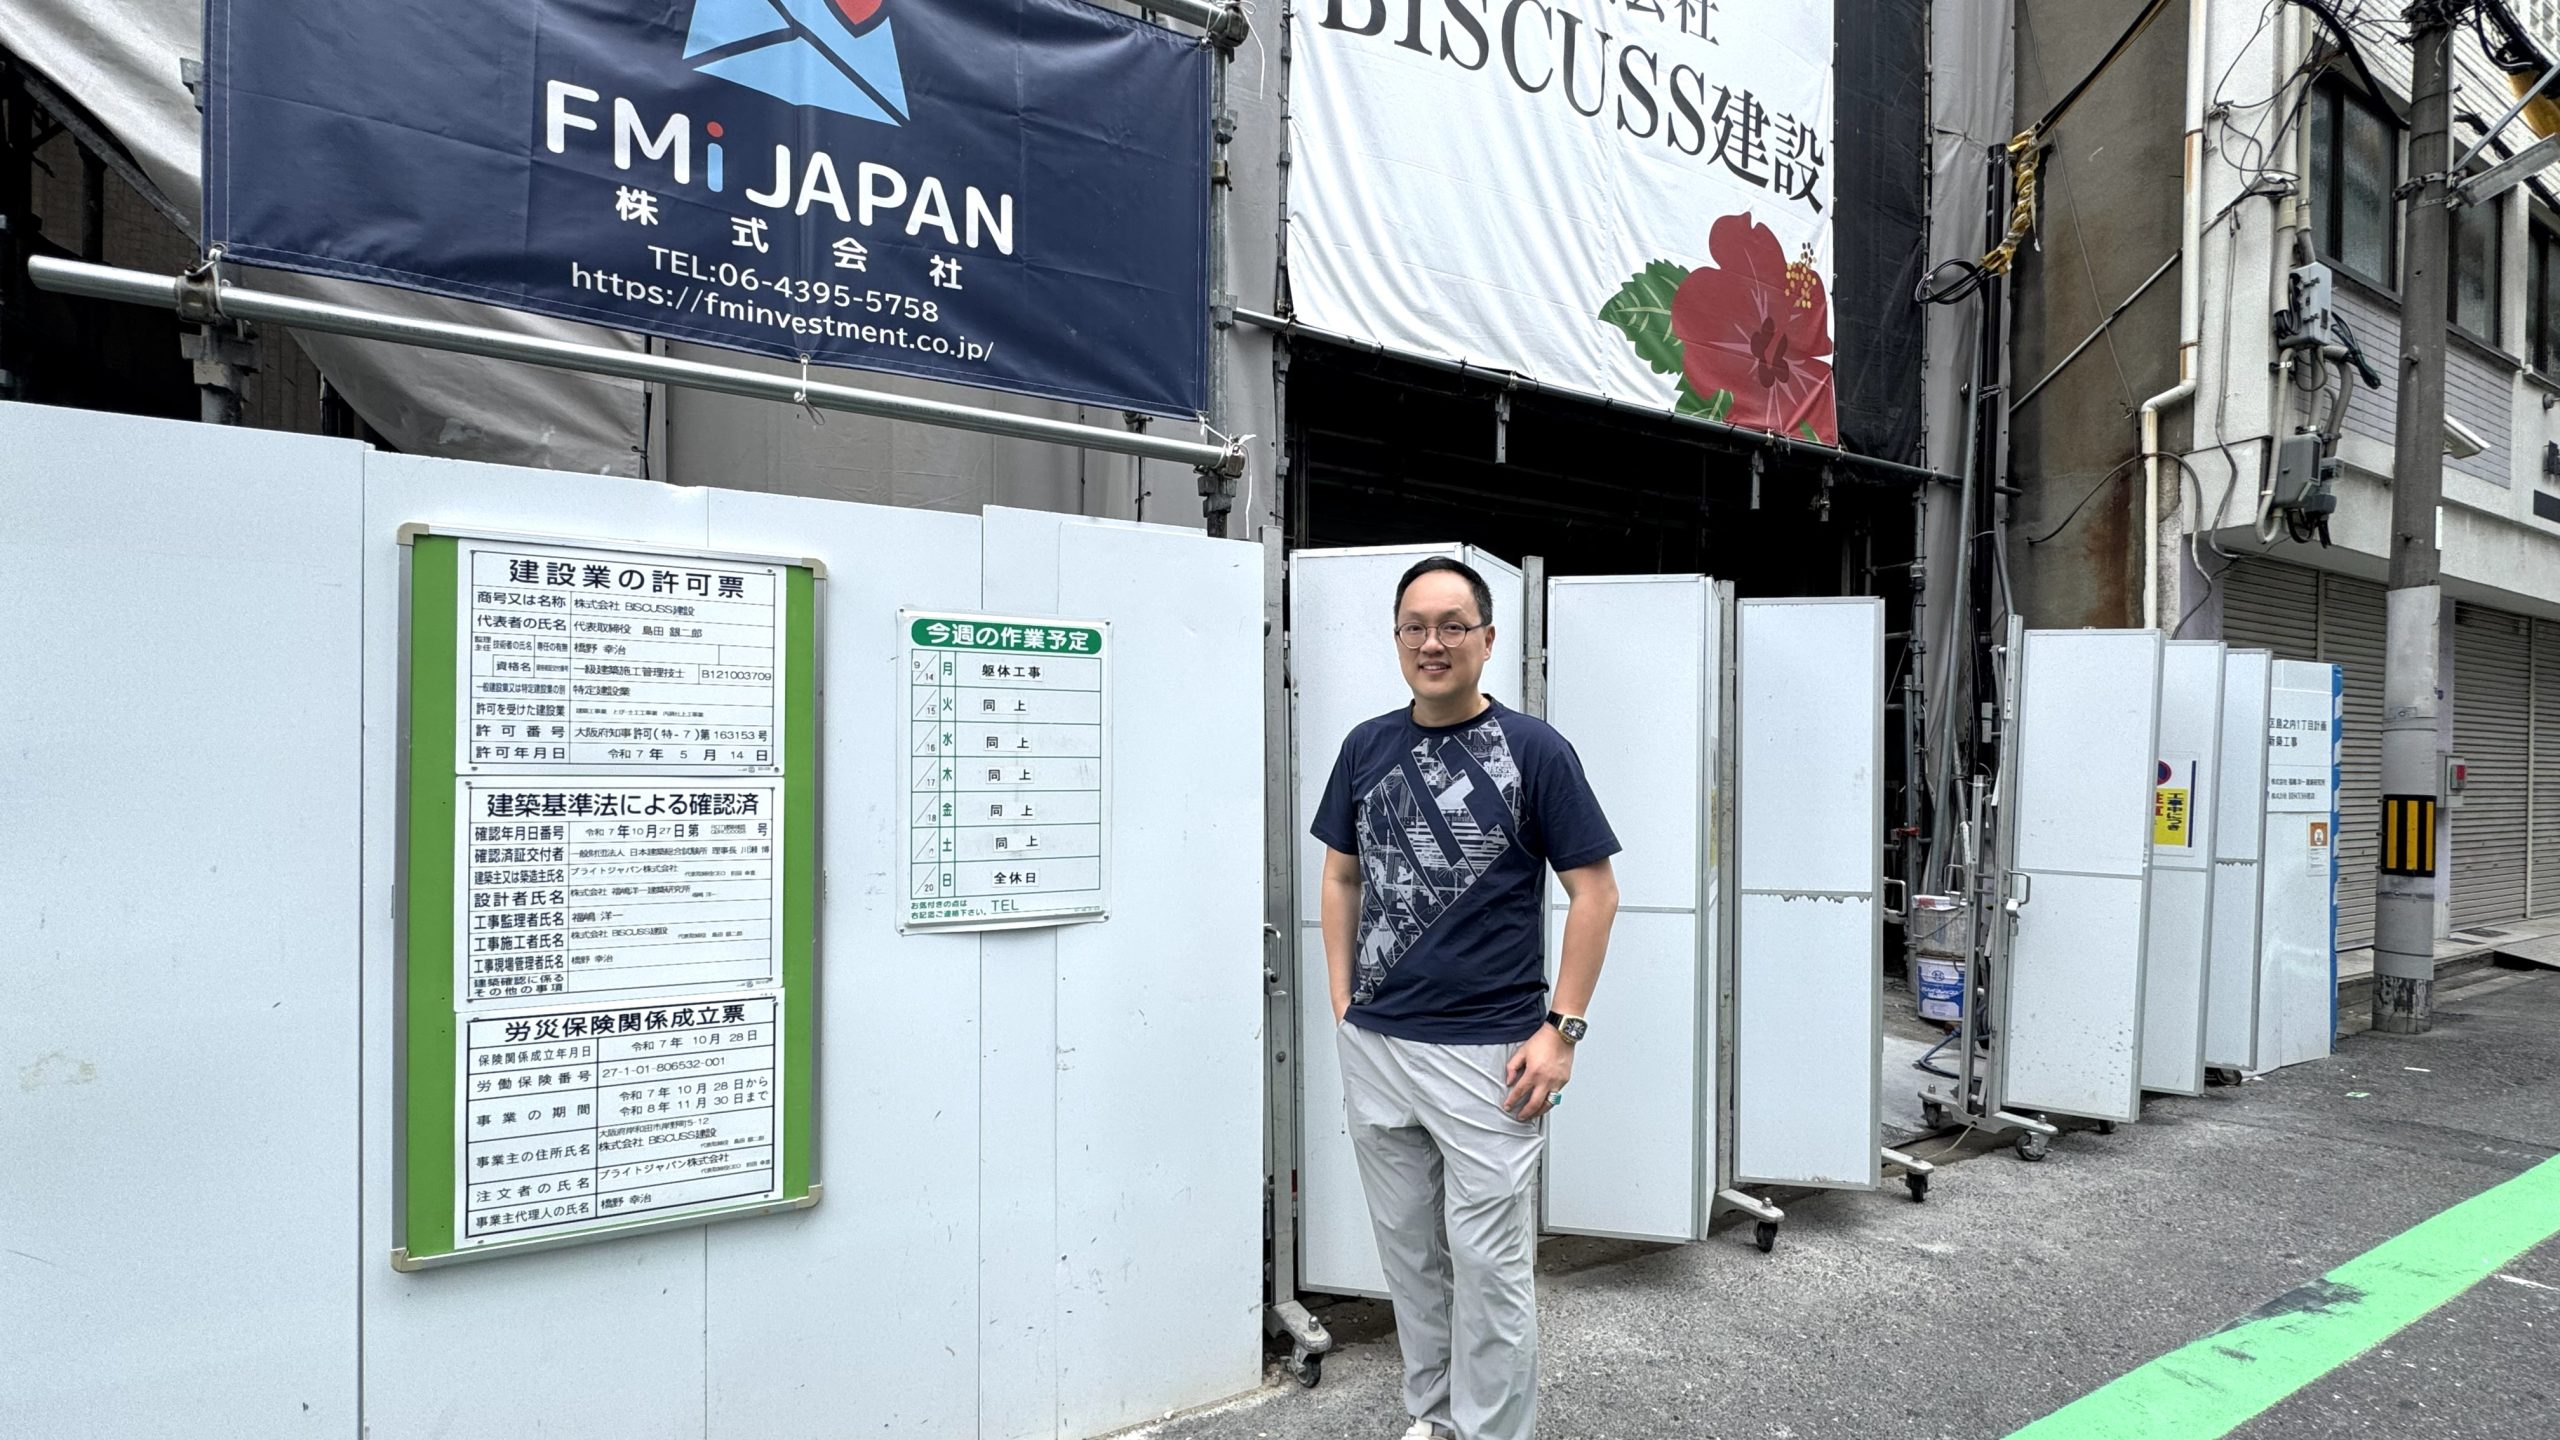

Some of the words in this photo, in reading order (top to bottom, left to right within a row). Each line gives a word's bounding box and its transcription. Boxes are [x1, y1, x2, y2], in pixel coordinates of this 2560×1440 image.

[745, 144, 1014, 256] JAPAN
[615, 185, 963, 291] 株式会社
[648, 245, 939, 323] TEL:06-4395-5758
[571, 262, 995, 362] https://fminvestment.co.jp/
[510, 558, 745, 599] 建設業の許可票
[477, 590, 566, 609] 商号又は名称
[574, 598, 620, 611] 株式会社
[477, 615, 566, 632] 代表者の氏名
[574, 621, 632, 634] 代表取締役
[926, 622, 1089, 651] 今週の作業予定
[496, 661, 531, 672] 資格名
[573, 664, 686, 679] 一級建築施工管理技士
[701, 669, 772, 681] B121003709
[943, 661, 953, 676] 月
[982, 664, 1041, 679] 躯体工事
[573, 685, 630, 696] 特定建設業
[476, 701, 565, 717] 許可を受けた建設業
[943, 697, 953, 712] 火
[476, 724, 565, 738] 許可番号
[943, 732, 953, 746] 水
[476, 745, 565, 759] 許可年月日
[942, 767, 952, 781] 木
[487, 792, 759, 818] 建築基準法による確認済
[942, 803, 952, 817] 金
[475, 825, 564, 841] 確認年月日番号
[942, 838, 952, 852] 土
[475, 847, 564, 863] 確認済証交付者
[475, 868, 564, 886] 建築主又は築造主氏名
[943, 873, 952, 887] 日
[993, 872, 1036, 884] 全休日
[474, 890, 564, 908] 設計者氏名
[570, 888, 607, 898] 株式会社
[911, 900, 967, 910] お気付きの点は
[991, 899, 1019, 912] TEL
[474, 911, 564, 930] 工事監理者氏名
[474, 932, 564, 952] 工事施工者氏名
[570, 929, 608, 940] 株式会社
[474, 954, 564, 974] 工事現場管理者氏名
[474, 974, 564, 987] 建築確認に係る
[476, 983, 563, 997] その他の事項
[504, 1003, 746, 1043] 労災保険関係成立票
[478, 1045, 592, 1067] 保険関係成立年月日
[477, 1070, 592, 1093] 労働保険番号
[602, 1057, 726, 1078] 27-1-01-806532-001
[476, 1105, 591, 1128] 事業の期間
[476, 1143, 591, 1169] 事業主の住所氏名
[599, 1138, 644, 1152] 株式会社
[476, 1177, 590, 1203] 注文者の氏名
[476, 1202, 590, 1229] 事業主代理人の氏名
